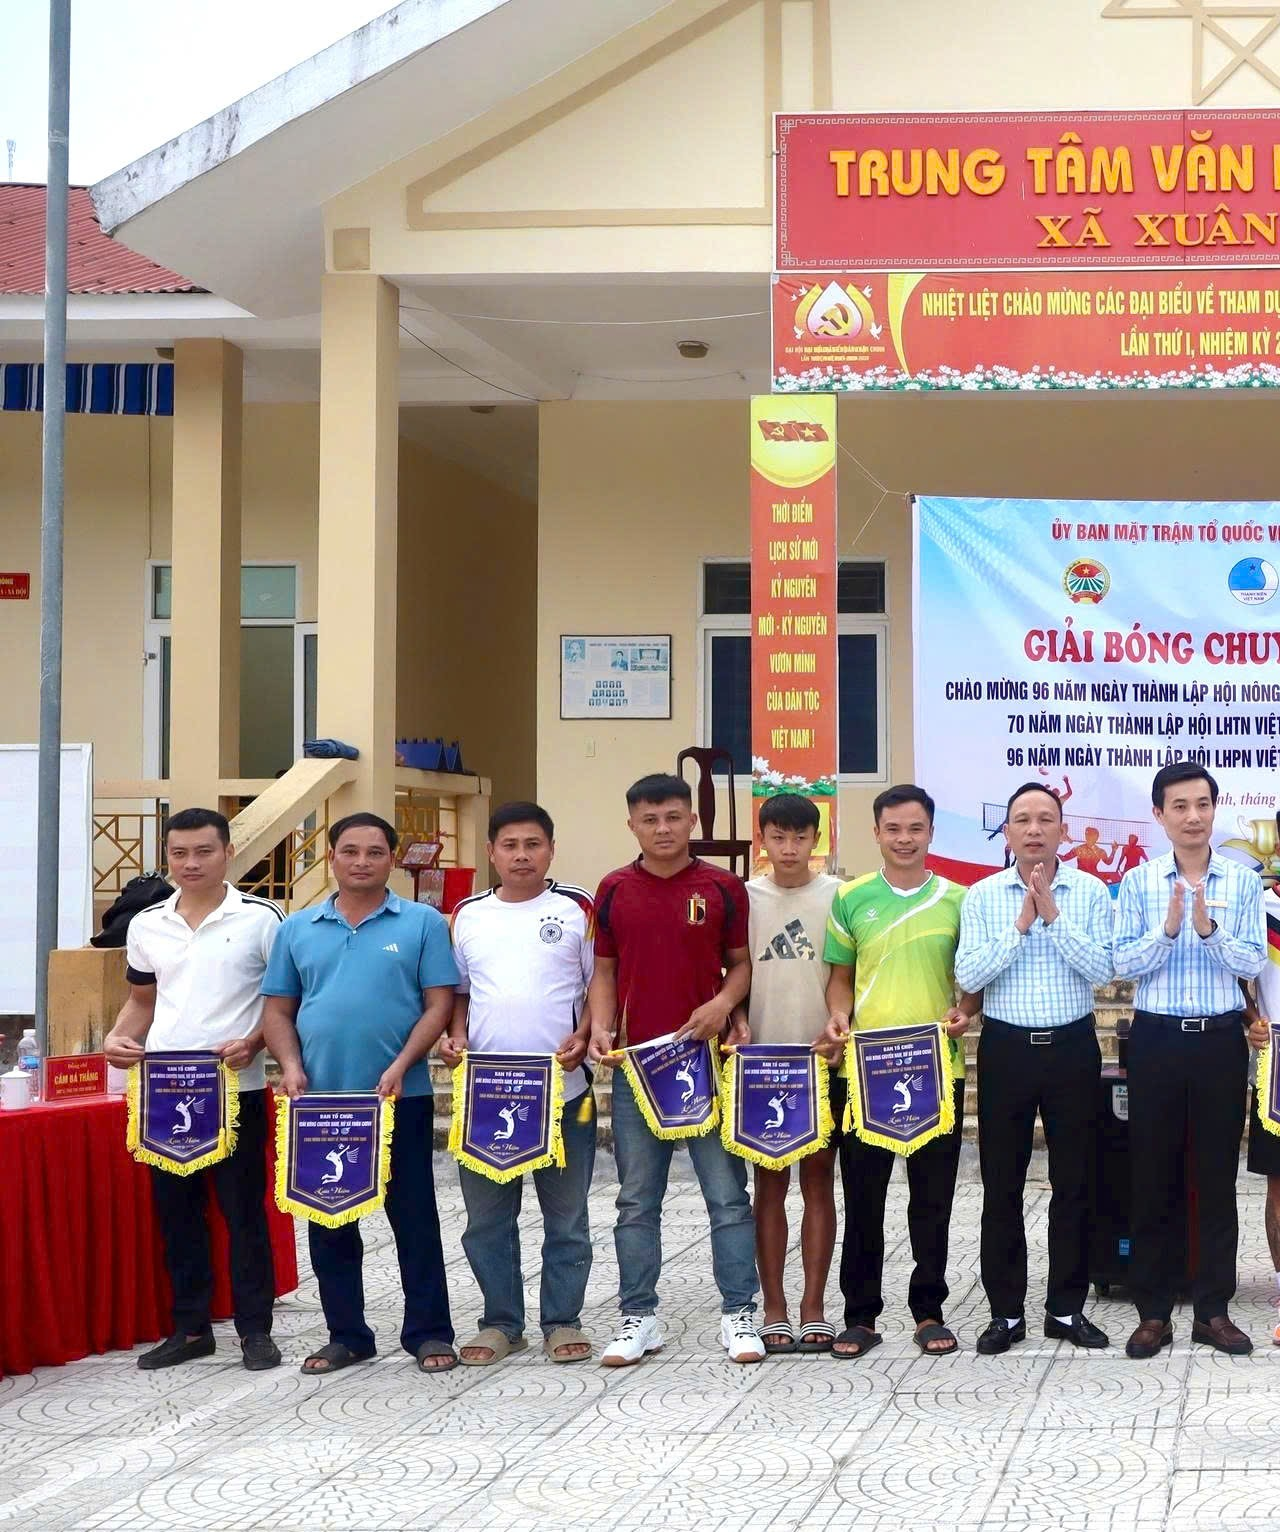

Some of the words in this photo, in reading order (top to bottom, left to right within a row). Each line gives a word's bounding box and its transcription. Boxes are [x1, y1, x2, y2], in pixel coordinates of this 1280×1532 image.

[829, 147, 1006, 197] TRUNG
[1026, 132, 1134, 195] TÂM
[1150, 129, 1255, 193] VĂN
[1035, 207, 1111, 249] XÃ
[1133, 203, 1279, 247] XUÂN
[922, 287, 965, 322] NHIỆT
[969, 287, 999, 322] LIỆT
[1003, 286, 1043, 316] CHÀO
[1047, 286, 1092, 316] MỪNG
[1095, 286, 1125, 315] CÁC
[1129, 290, 1154, 320] ĐẠI
[1158, 281, 1192, 315] BIỂU
[1196, 283, 1215, 314] VỀ
[1218, 290, 1260, 314] THAM
[1120, 324, 1149, 356] LẦN
[1153, 327, 1183, 356] THỨ
[1185, 332, 1195, 359] I,
[1199, 327, 1248, 361] NHIỆM
[1252, 326, 1271, 356] KỲ
[772, 500, 790, 523] THỜI
[791, 496, 813, 523] ĐIỂM
[1051, 517, 1072, 542] ỦY
[1076, 522, 1109, 542] BAN
[1113, 521, 1148, 546] MẶT
[1151, 521, 1194, 546] TRẬN
[1198, 518, 1218, 542] TỔ
[1221, 518, 1264, 543] QUỐC
[769, 541, 788, 565] LỊCH
[789, 534, 802, 561] SỬ
[802, 538, 818, 561] MỚI
[771, 572, 782, 598] KỶ
[783, 574, 817, 598] NGUYÊN
[758, 612, 775, 636] MỚI
[781, 609, 793, 636] KỶ
[794, 612, 827, 636] NGUYÊN
[1023, 616, 1095, 663] GIẢI
[1103, 623, 1195, 664] BÓNG
[769, 651, 792, 674] VƯƠN
[793, 650, 816, 673] MÌNH
[766, 685, 783, 711] CỦA
[785, 689, 802, 711] DÂN
[803, 688, 820, 715] TỘC
[945, 680, 983, 702] CHÀO
[986, 679, 1029, 702] MỪNG
[1032, 682, 1050, 701] 96
[1053, 679, 1088, 702] NĂM
[1091, 680, 1129, 703] NGÀY
[1132, 680, 1179, 703] THÀNH
[1182, 679, 1209, 707] LẬP
[1213, 680, 1237, 707] HỘI
[1241, 680, 1280, 703] NÔNG
[771, 725, 789, 752] VIỆT
[790, 729, 810, 749] NAM
[811, 729, 816, 748] !
[1007, 715, 1024, 734] 70
[1028, 711, 1061, 734] NĂM
[1065, 713, 1103, 735] NGÀY
[1107, 712, 1153, 736] THÀNH
[1157, 712, 1184, 739] LẬP
[1188, 712, 1211, 740] HỘI
[1215, 716, 1250, 736] LHTN
[1007, 748, 1024, 767] 96
[1028, 744, 1061, 767] NĂM
[1065, 746, 1101, 768] NGÀY
[1107, 745, 1153, 768] THÀNH
[1215, 749, 1251, 769] LHPN
[1240, 792, 1276, 808] tháng
